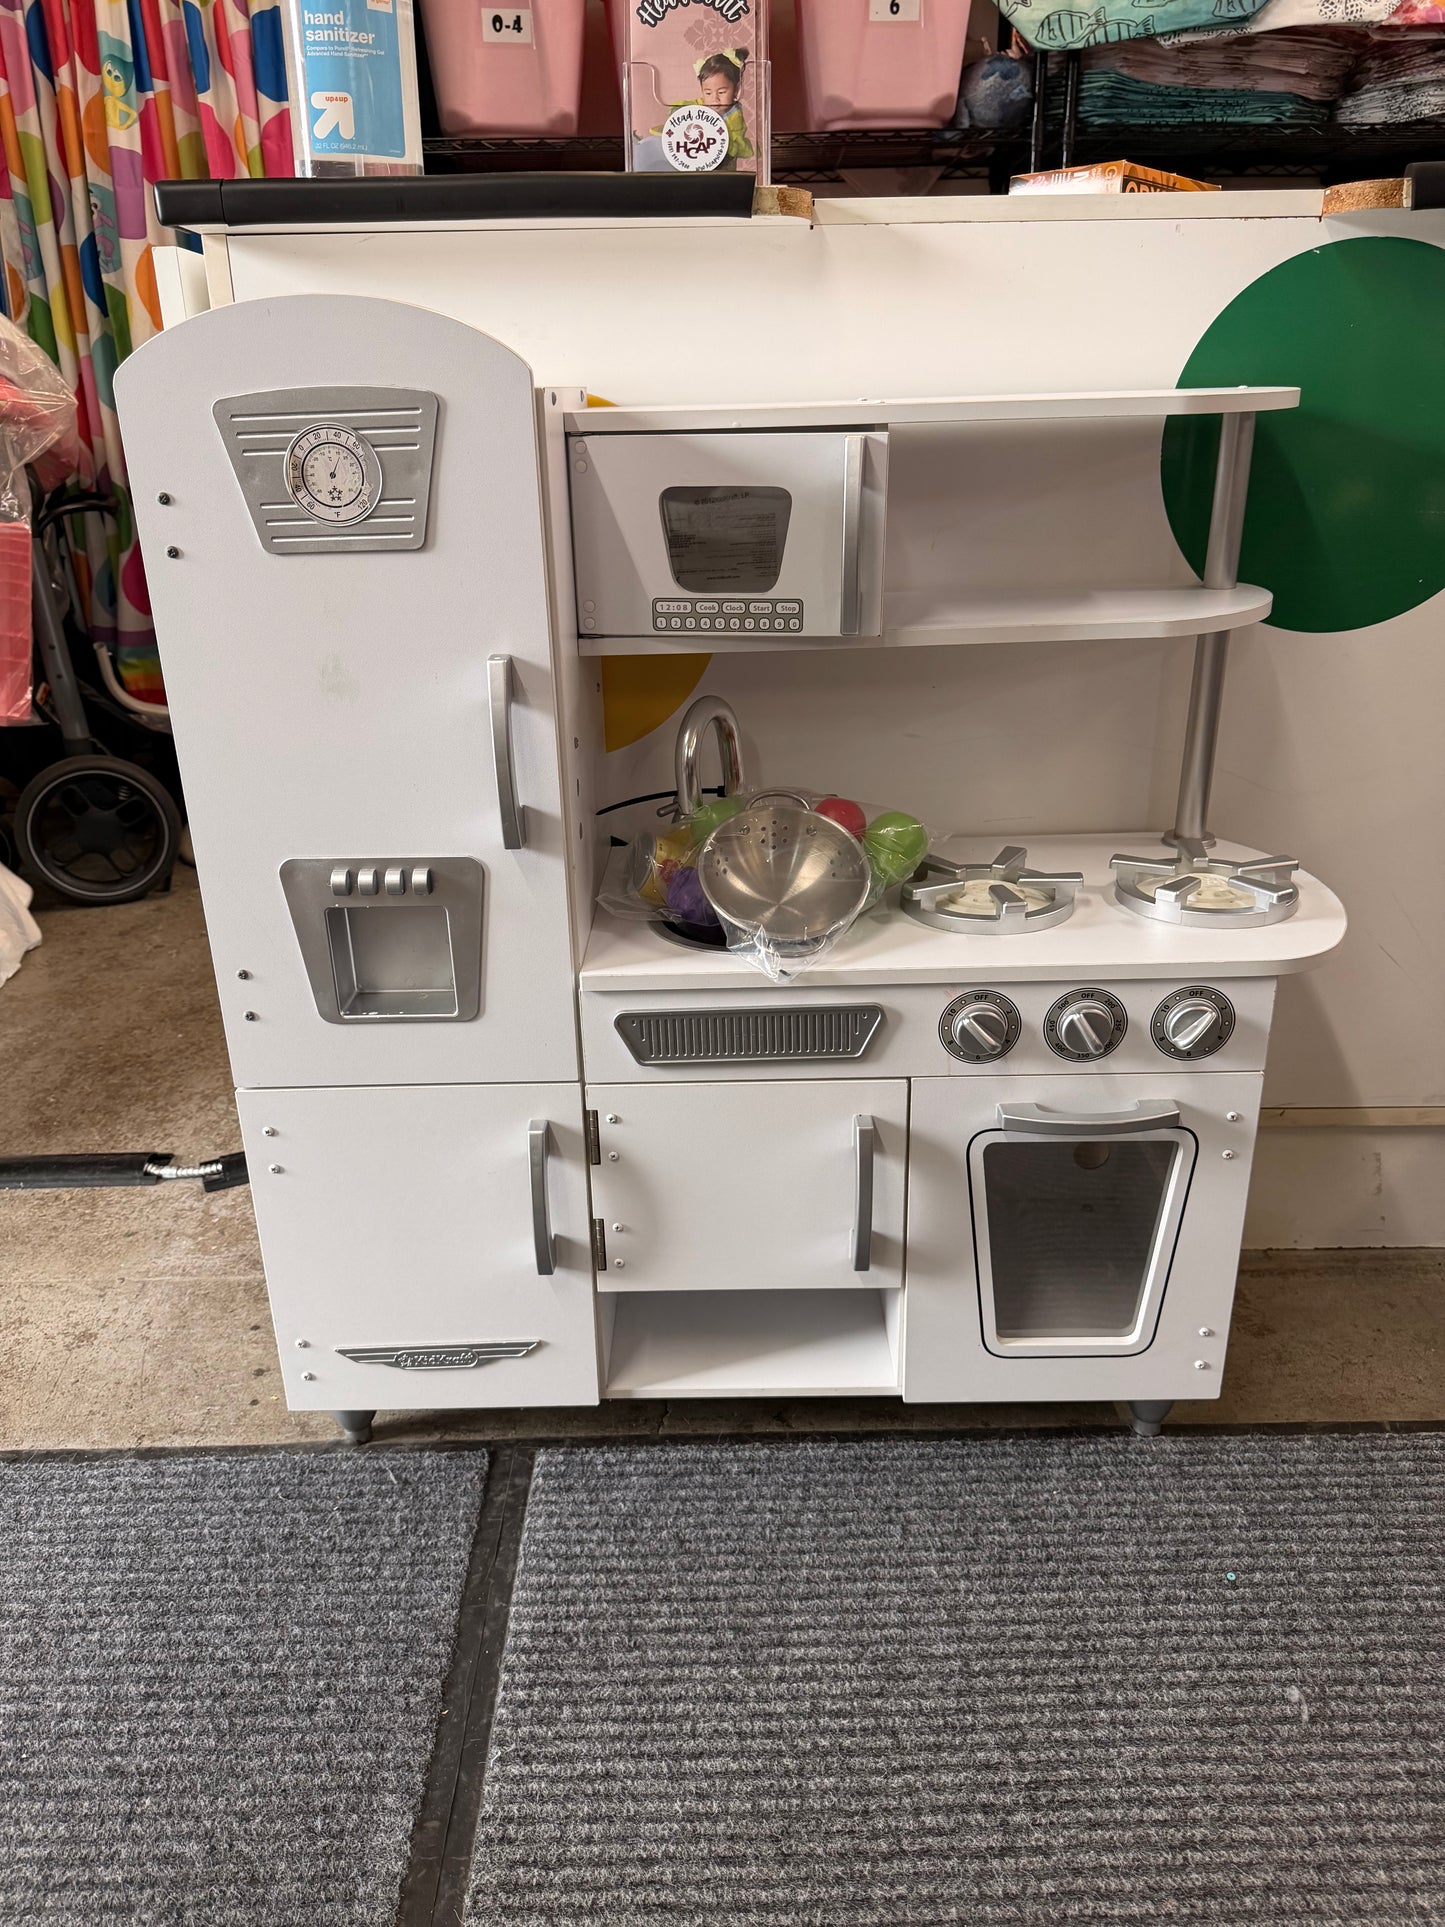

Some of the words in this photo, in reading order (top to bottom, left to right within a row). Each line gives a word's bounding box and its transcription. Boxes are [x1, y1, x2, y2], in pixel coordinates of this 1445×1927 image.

[889, 0, 900, 15] 6
[304, 10, 344, 25] hand
[492, 14, 523, 33] 0-4
[305, 27, 375, 44] sanitizer
[669, 110, 693, 128] Head
[695, 109, 722, 128] Start
[676, 137, 717, 159] HCAP
[312, 431, 322, 440] 20
[332, 431, 342, 439] 40
[357, 498, 368, 510] 120
[725, 604, 744, 612] Clock
[780, 605, 797, 613] Stop
[948, 1008, 956, 1017] 10
[1161, 1004, 1170, 1013] 10
